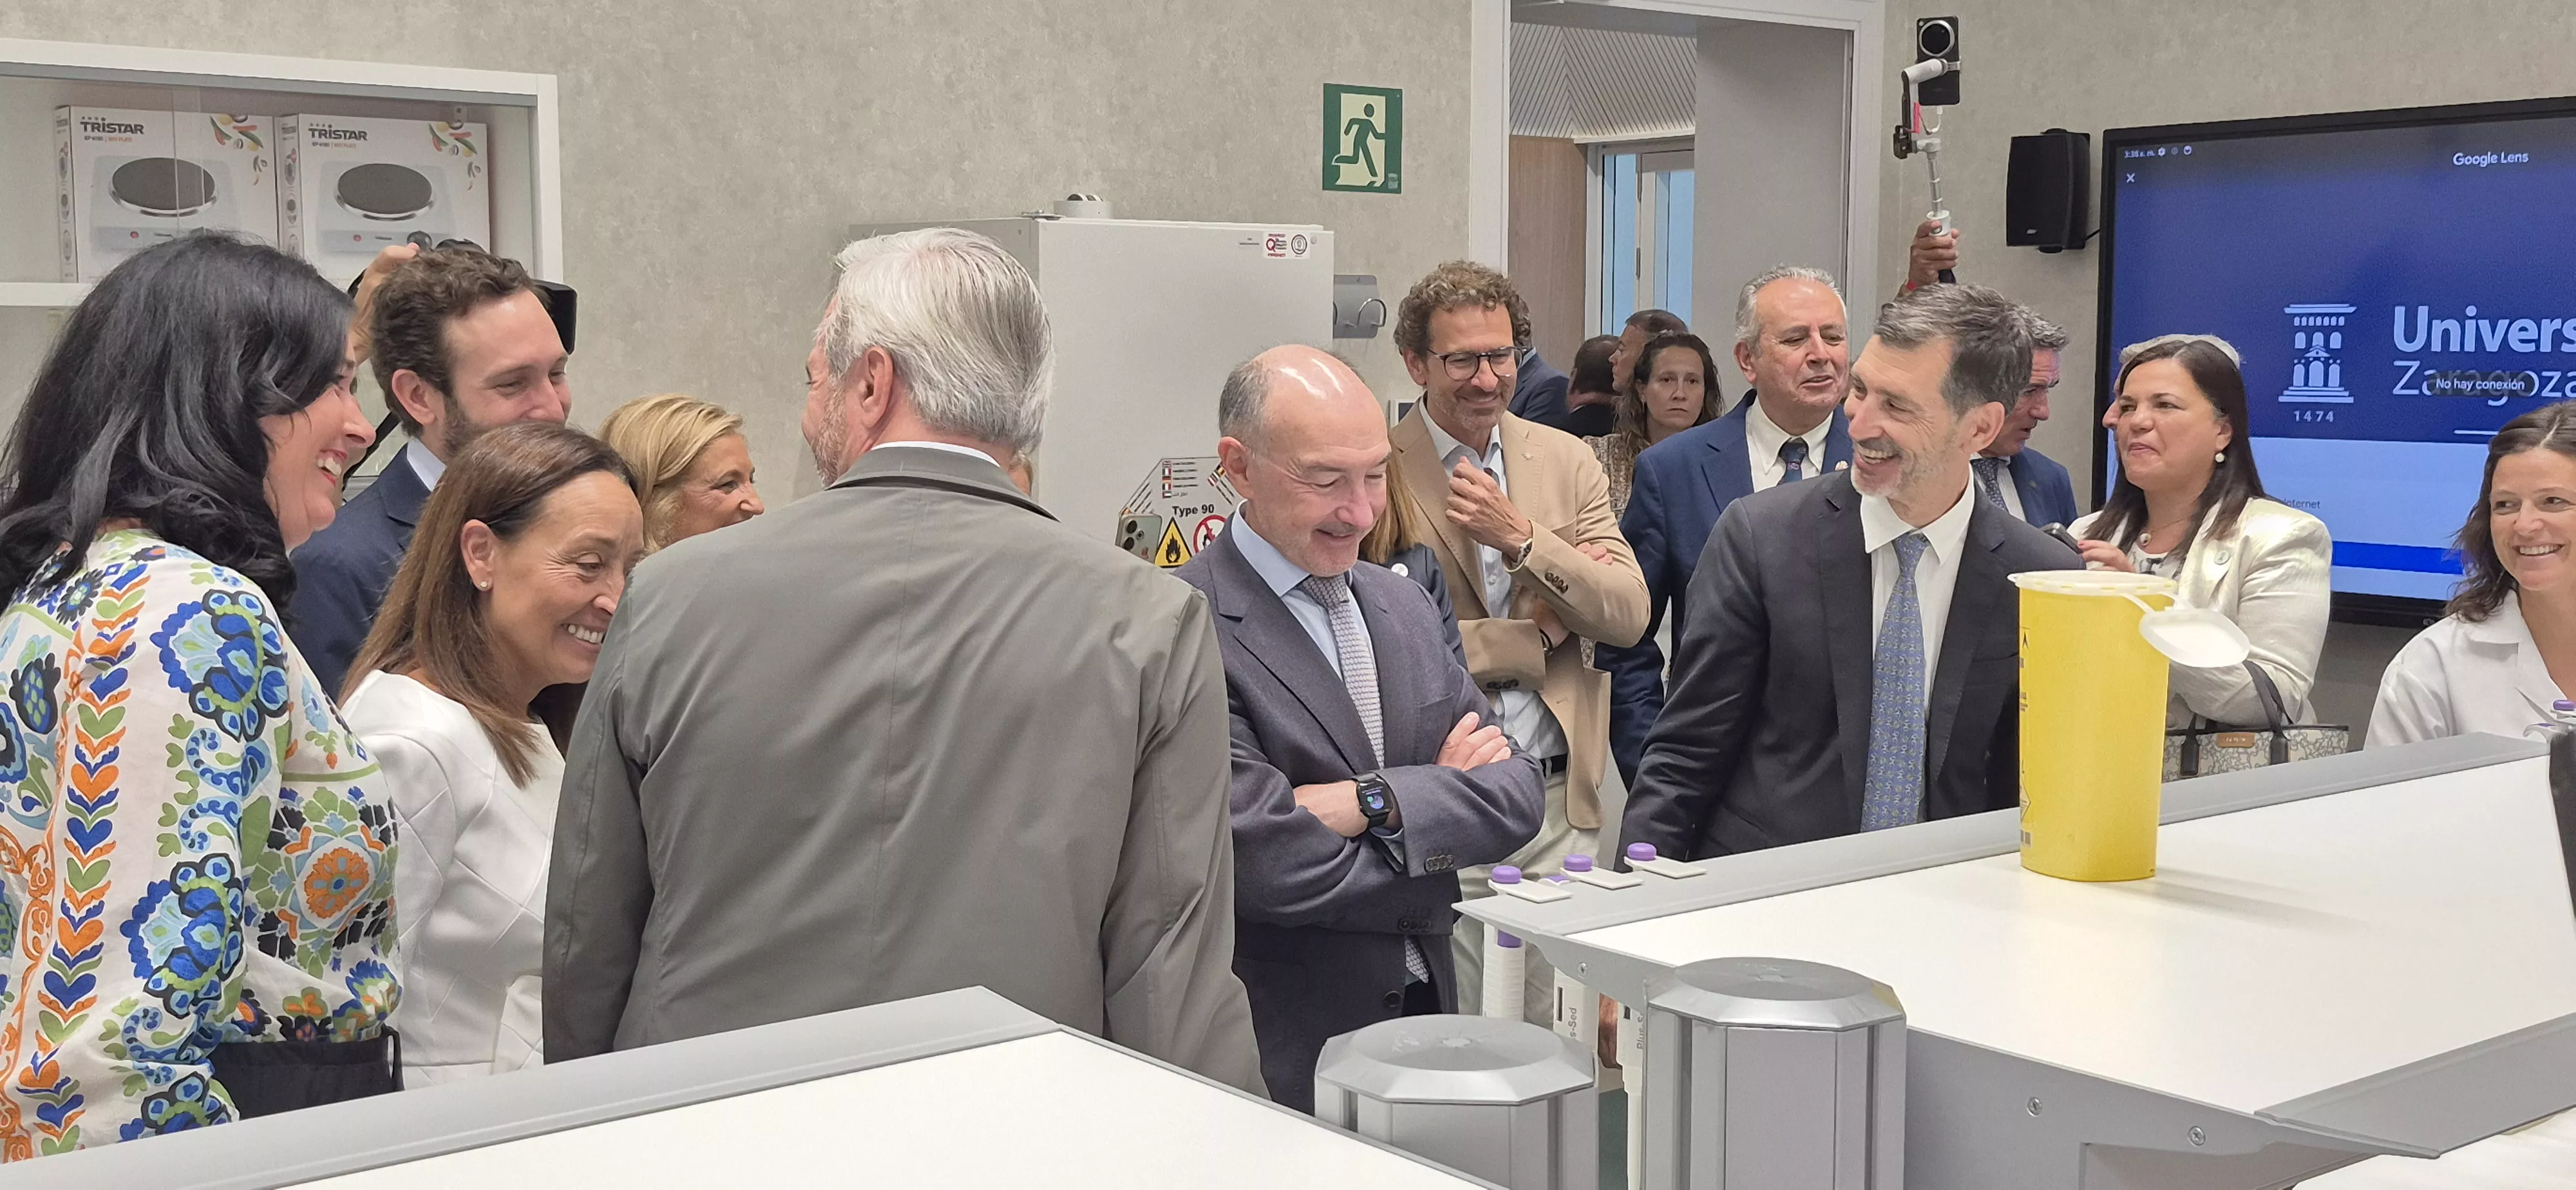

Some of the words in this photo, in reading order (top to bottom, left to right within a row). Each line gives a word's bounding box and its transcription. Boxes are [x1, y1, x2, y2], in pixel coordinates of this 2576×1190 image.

[2452, 151, 2499, 167] Google
[2501, 151, 2530, 164] Lens
[2436, 378, 2452, 389] No
[2454, 378, 2474, 392] hay
[2476, 379, 2525, 390] conexión
[2293, 410, 2334, 423] 1474
[1171, 505, 1198, 518] Type
[1201, 504, 1215, 514] 90
